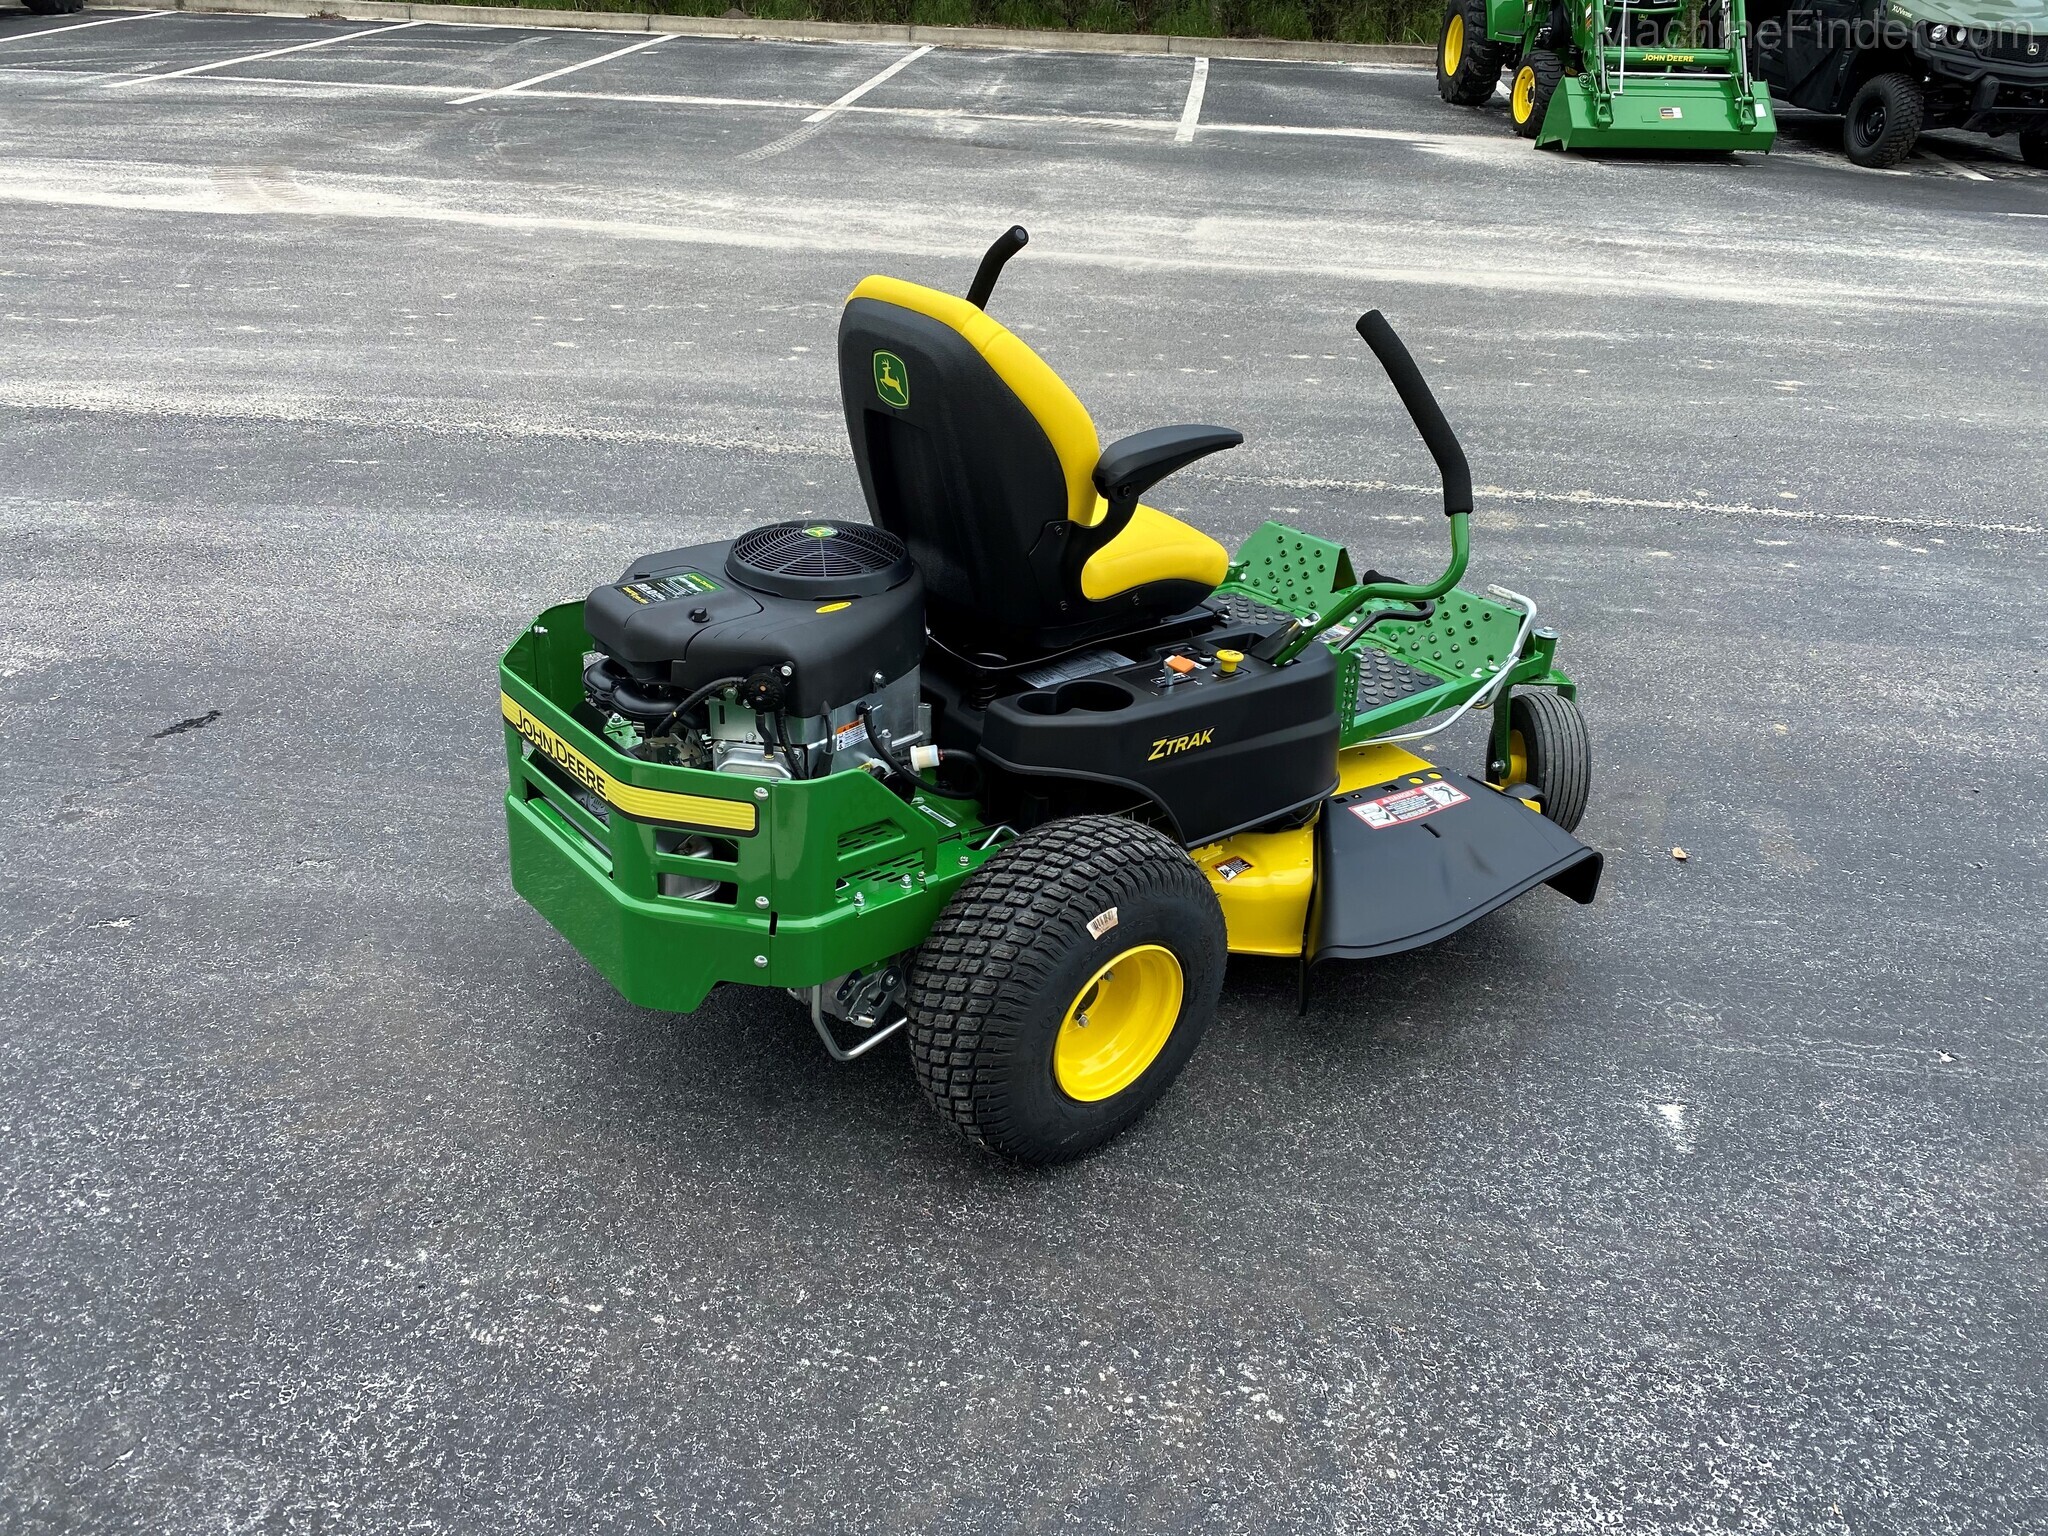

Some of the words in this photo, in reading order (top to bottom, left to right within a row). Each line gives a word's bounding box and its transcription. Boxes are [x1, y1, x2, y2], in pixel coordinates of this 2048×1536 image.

[1643, 53, 1665, 61] JOHN
[1667, 54, 1694, 62] DEERE
[516, 710, 553, 757] JOHN
[556, 739, 606, 797] DEERE
[1148, 728, 1215, 761] ZTRAK
